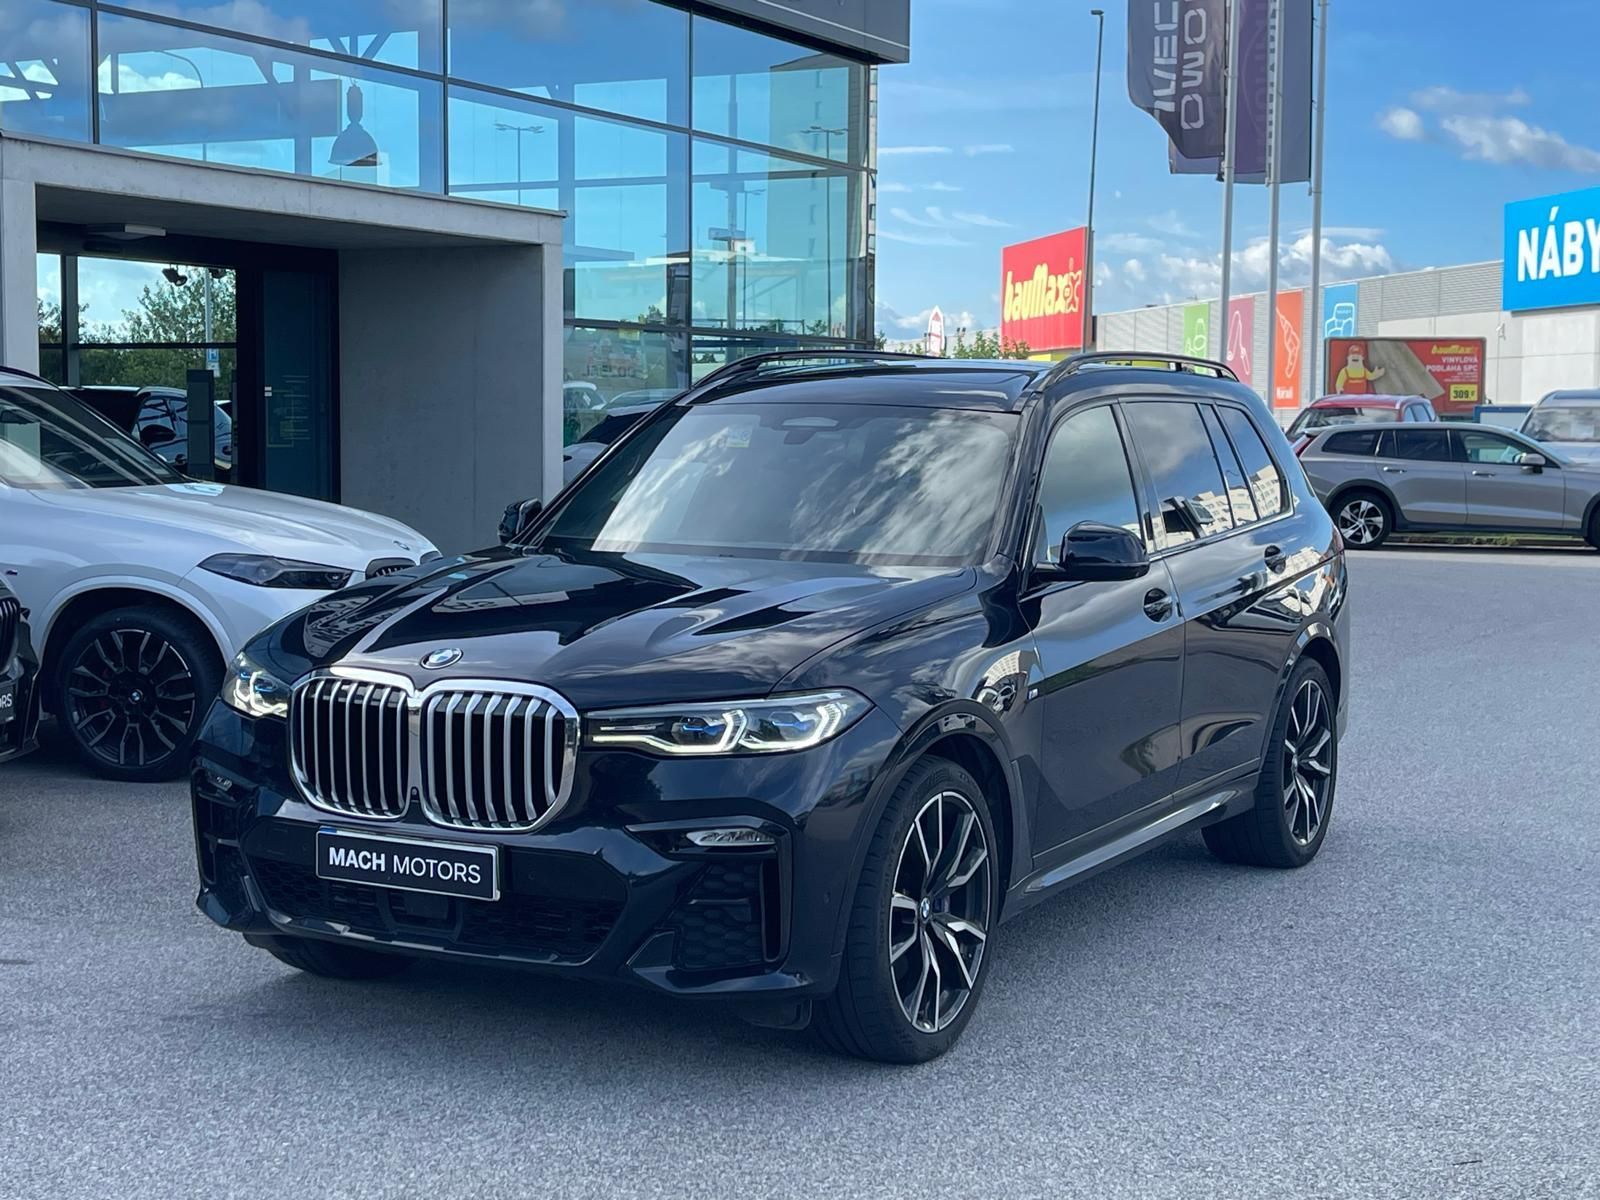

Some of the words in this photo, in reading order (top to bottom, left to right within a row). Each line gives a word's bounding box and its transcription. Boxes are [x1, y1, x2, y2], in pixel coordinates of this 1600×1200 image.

[1517, 205, 1600, 282] NÁBY
[329, 846, 386, 872] MACH
[393, 854, 481, 884] MOTORS
